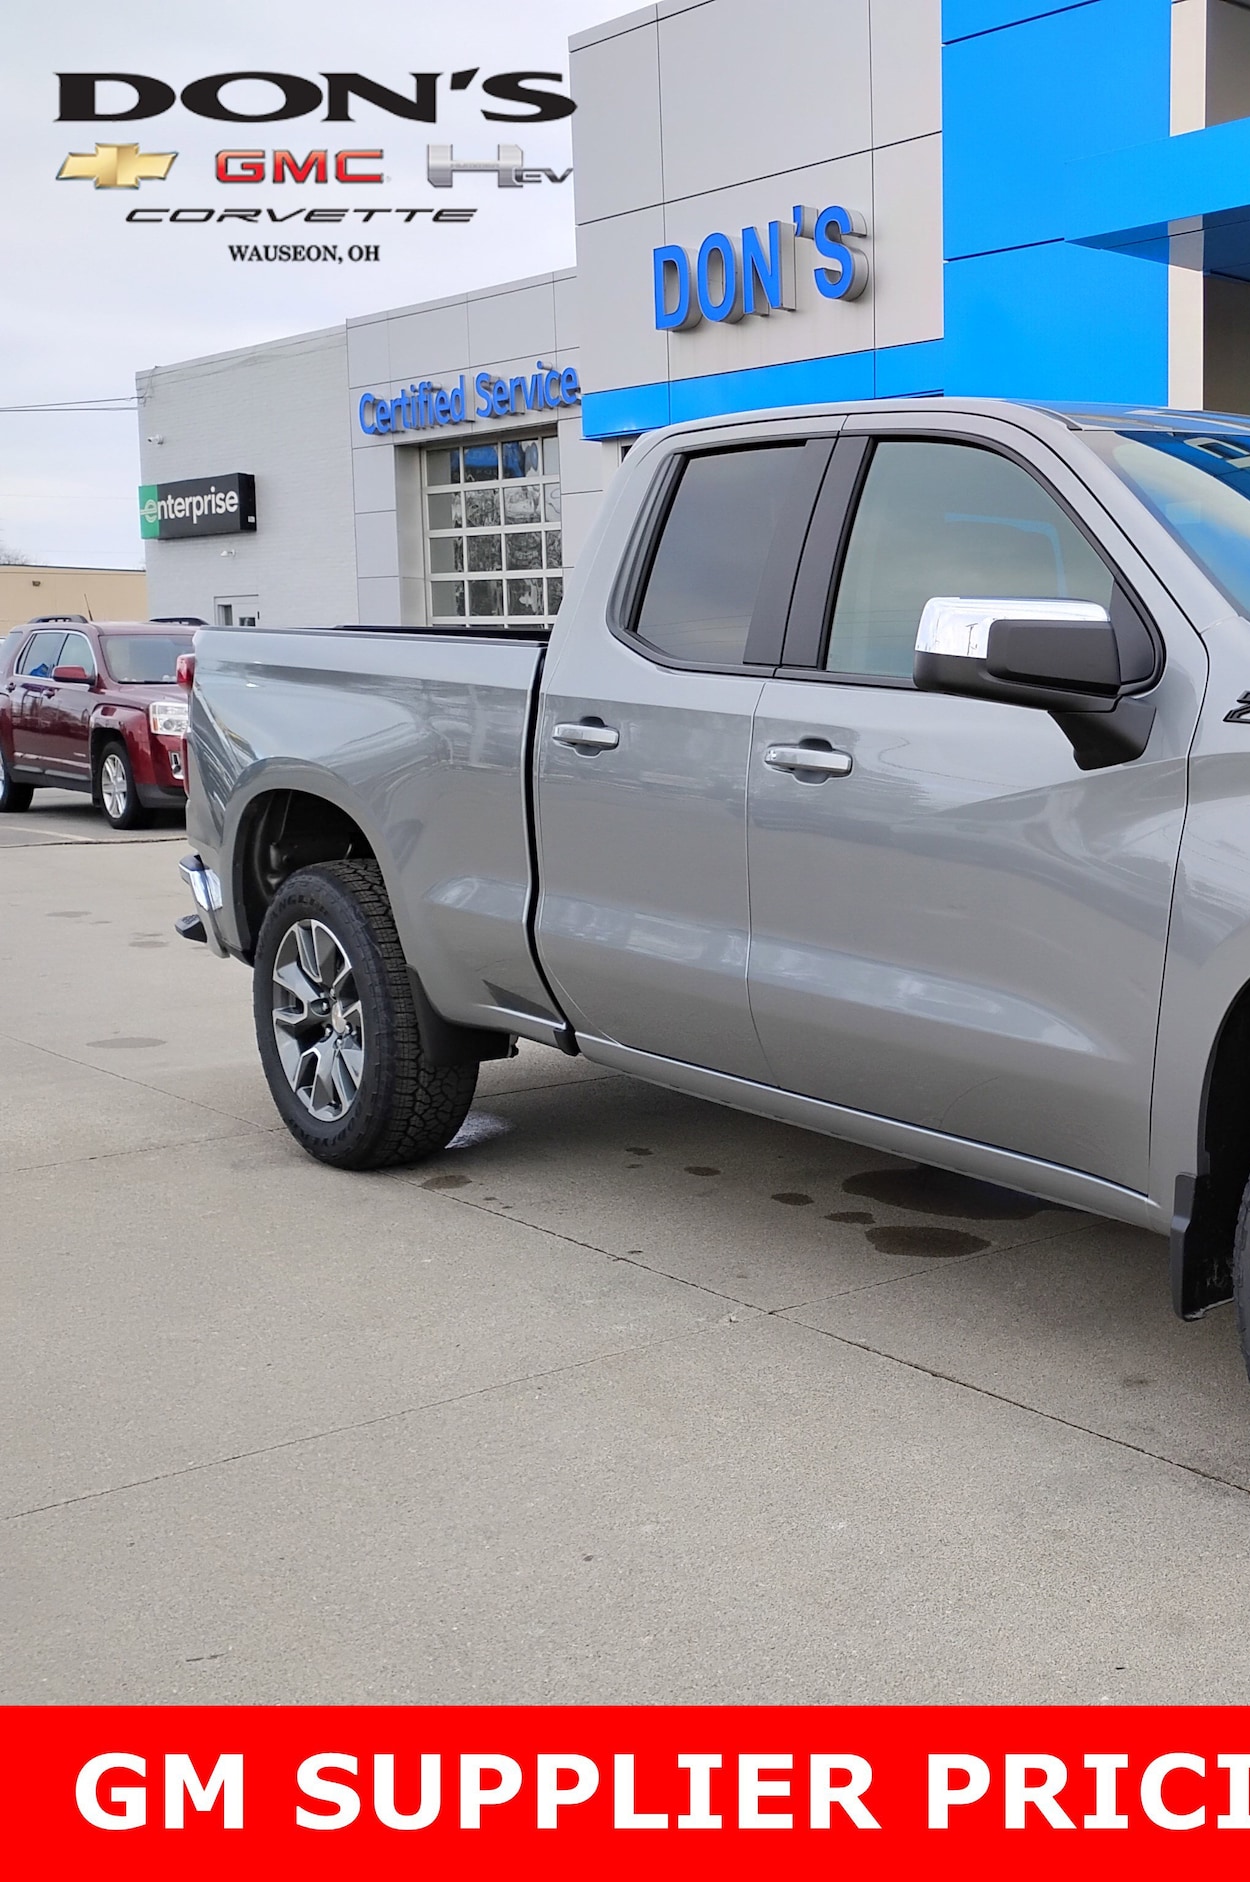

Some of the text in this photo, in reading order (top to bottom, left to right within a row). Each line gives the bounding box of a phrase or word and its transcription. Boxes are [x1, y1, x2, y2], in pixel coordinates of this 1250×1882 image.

[652, 204, 868, 331] DON'S
[359, 360, 579, 436] Certified Service
[139, 485, 239, 524] enterprise
